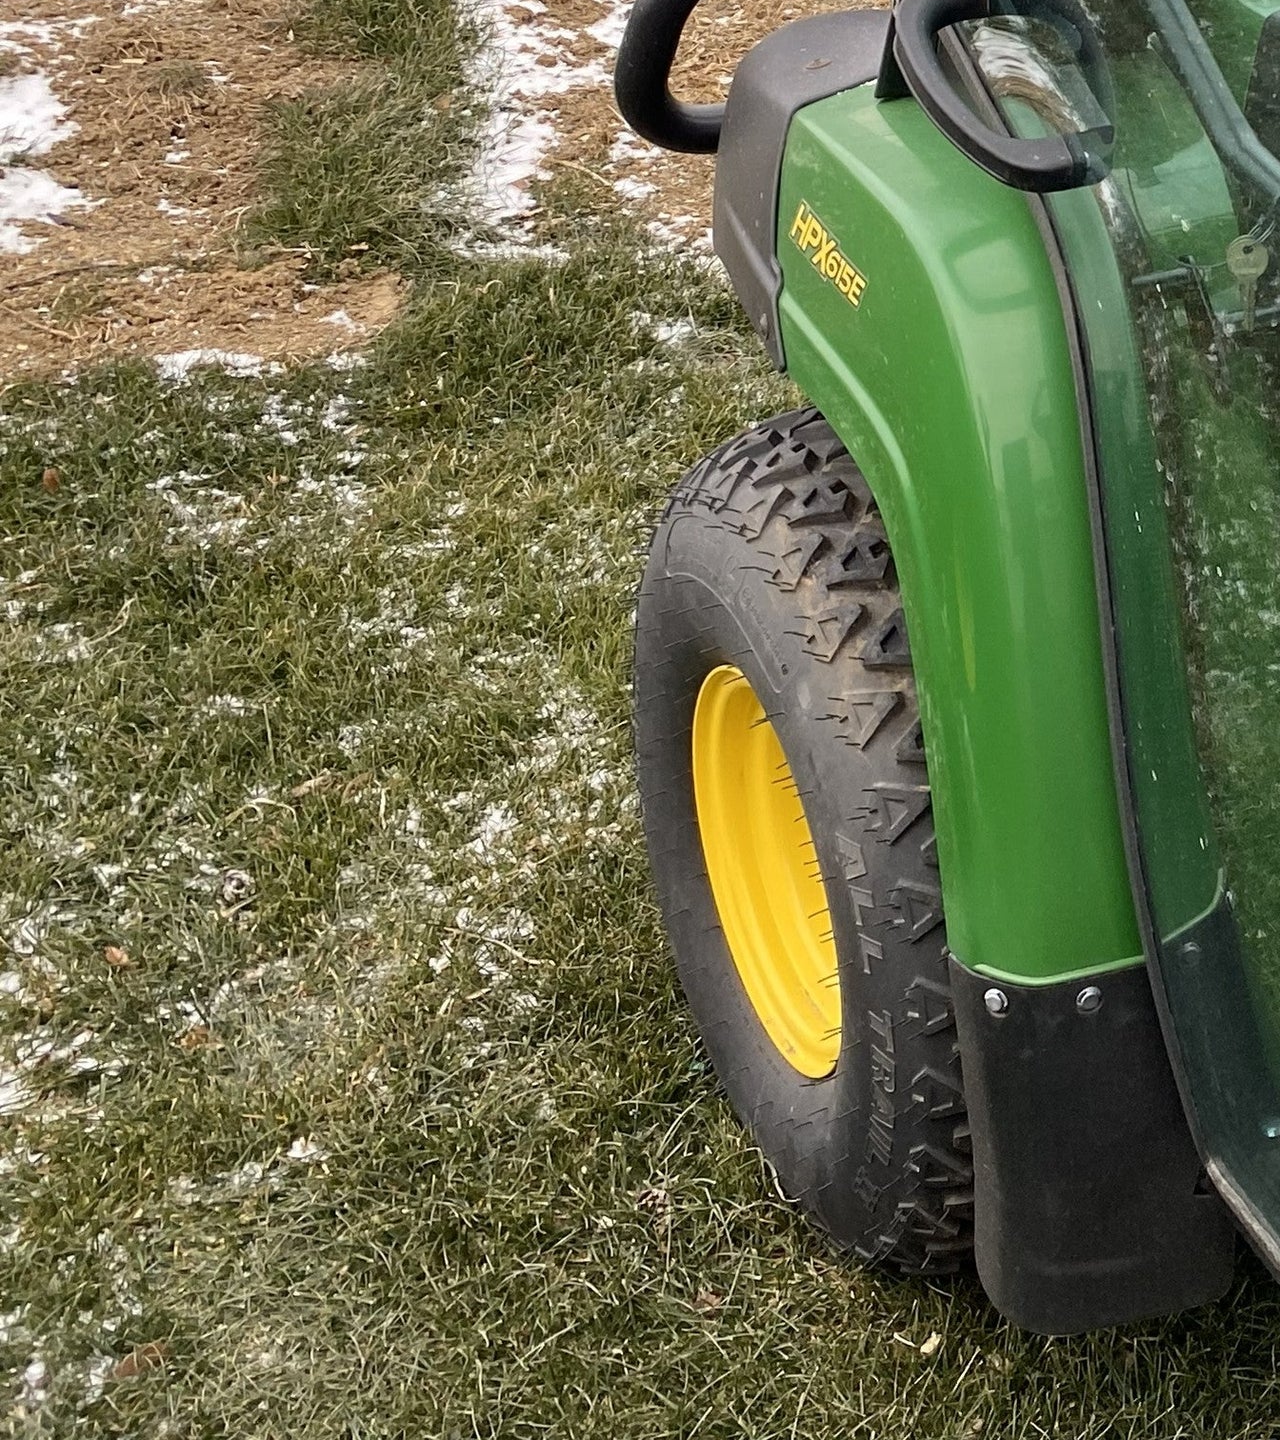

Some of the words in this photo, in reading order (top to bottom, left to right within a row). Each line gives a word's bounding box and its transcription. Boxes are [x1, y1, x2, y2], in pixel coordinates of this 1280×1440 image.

[790, 203, 867, 307] HPX615E
[834, 832, 884, 975] ALL
[864, 1008, 896, 1167] TRAIL
